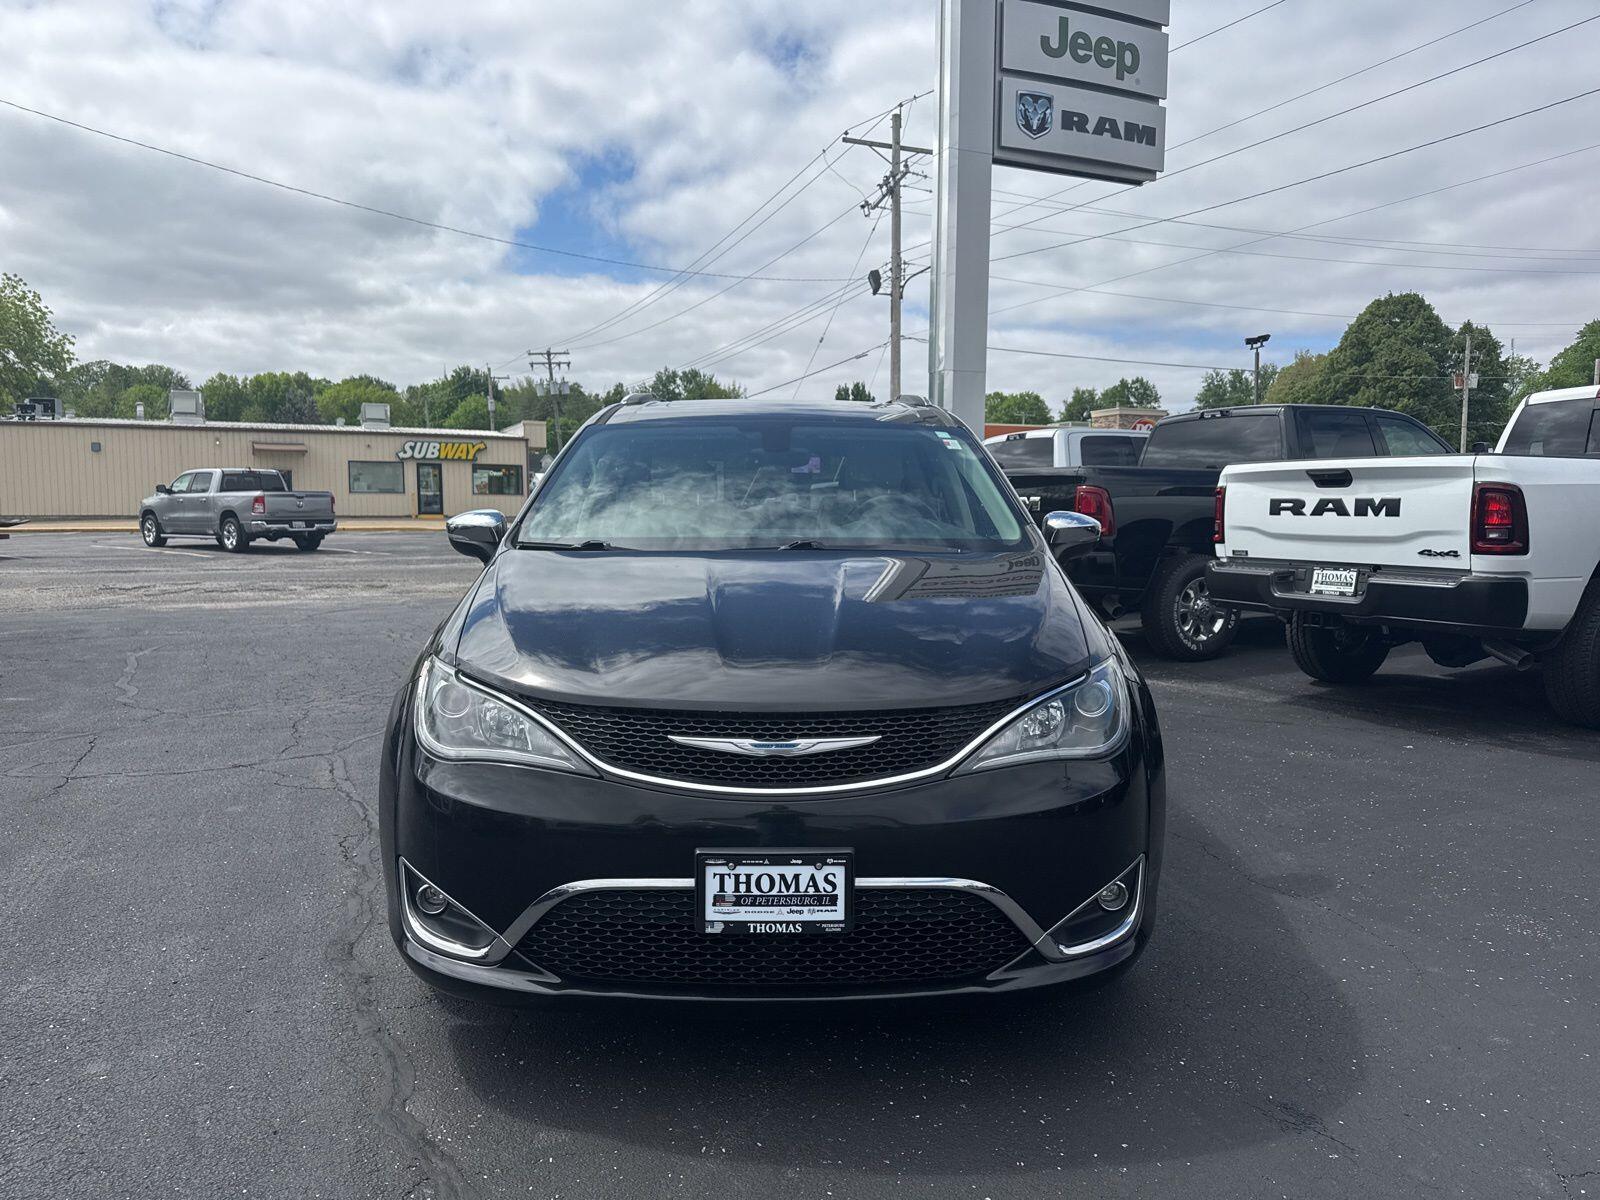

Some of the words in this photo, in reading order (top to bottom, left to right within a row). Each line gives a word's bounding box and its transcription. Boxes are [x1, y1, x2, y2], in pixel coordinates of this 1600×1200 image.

[1040, 16, 1140, 81] Jeep
[1061, 109, 1157, 147] RAM
[397, 440, 487, 461] SUBWAY
[1268, 497, 1402, 517] RAM
[1417, 549, 1460, 558] 4x4
[1315, 572, 1354, 583] THOMAS
[713, 872, 838, 894] THOMAS
[740, 897, 755, 906] OF
[756, 896, 820, 906] PETERSBURG,
[821, 897, 832, 905] IL
[786, 908, 805, 916] Jeep
[747, 923, 803, 934] THOMAS
